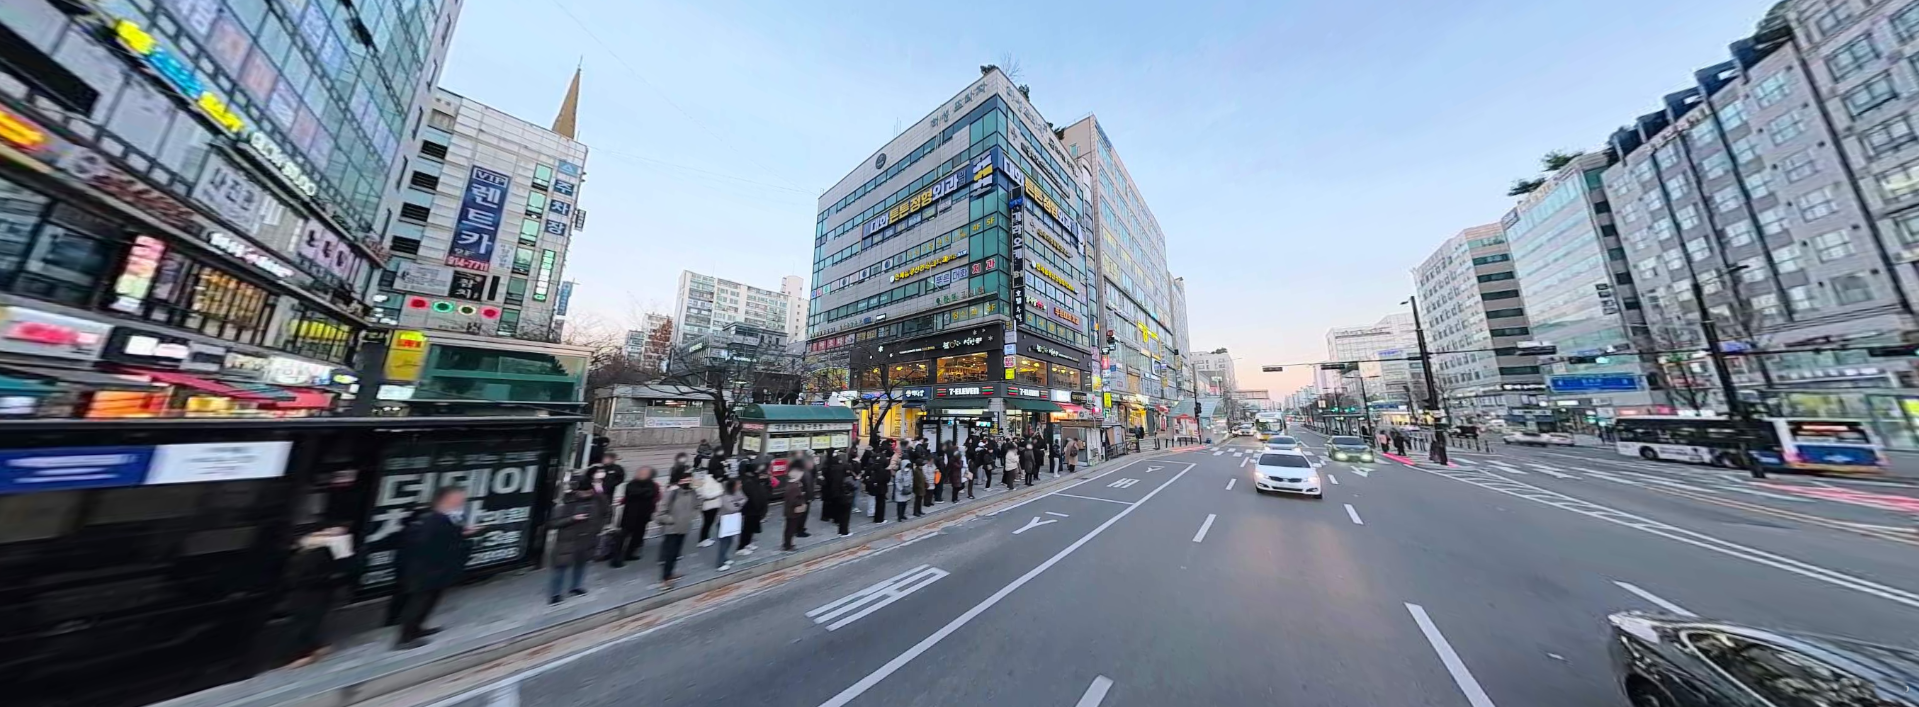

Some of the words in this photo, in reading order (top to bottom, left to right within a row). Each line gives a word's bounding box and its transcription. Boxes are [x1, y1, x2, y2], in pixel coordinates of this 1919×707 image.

[477, 171, 507, 186] VIP
[457, 183, 501, 255] 렌트카
[547, 181, 574, 235] 주차장
[949, 387, 980, 396] 7-ELEVEN
